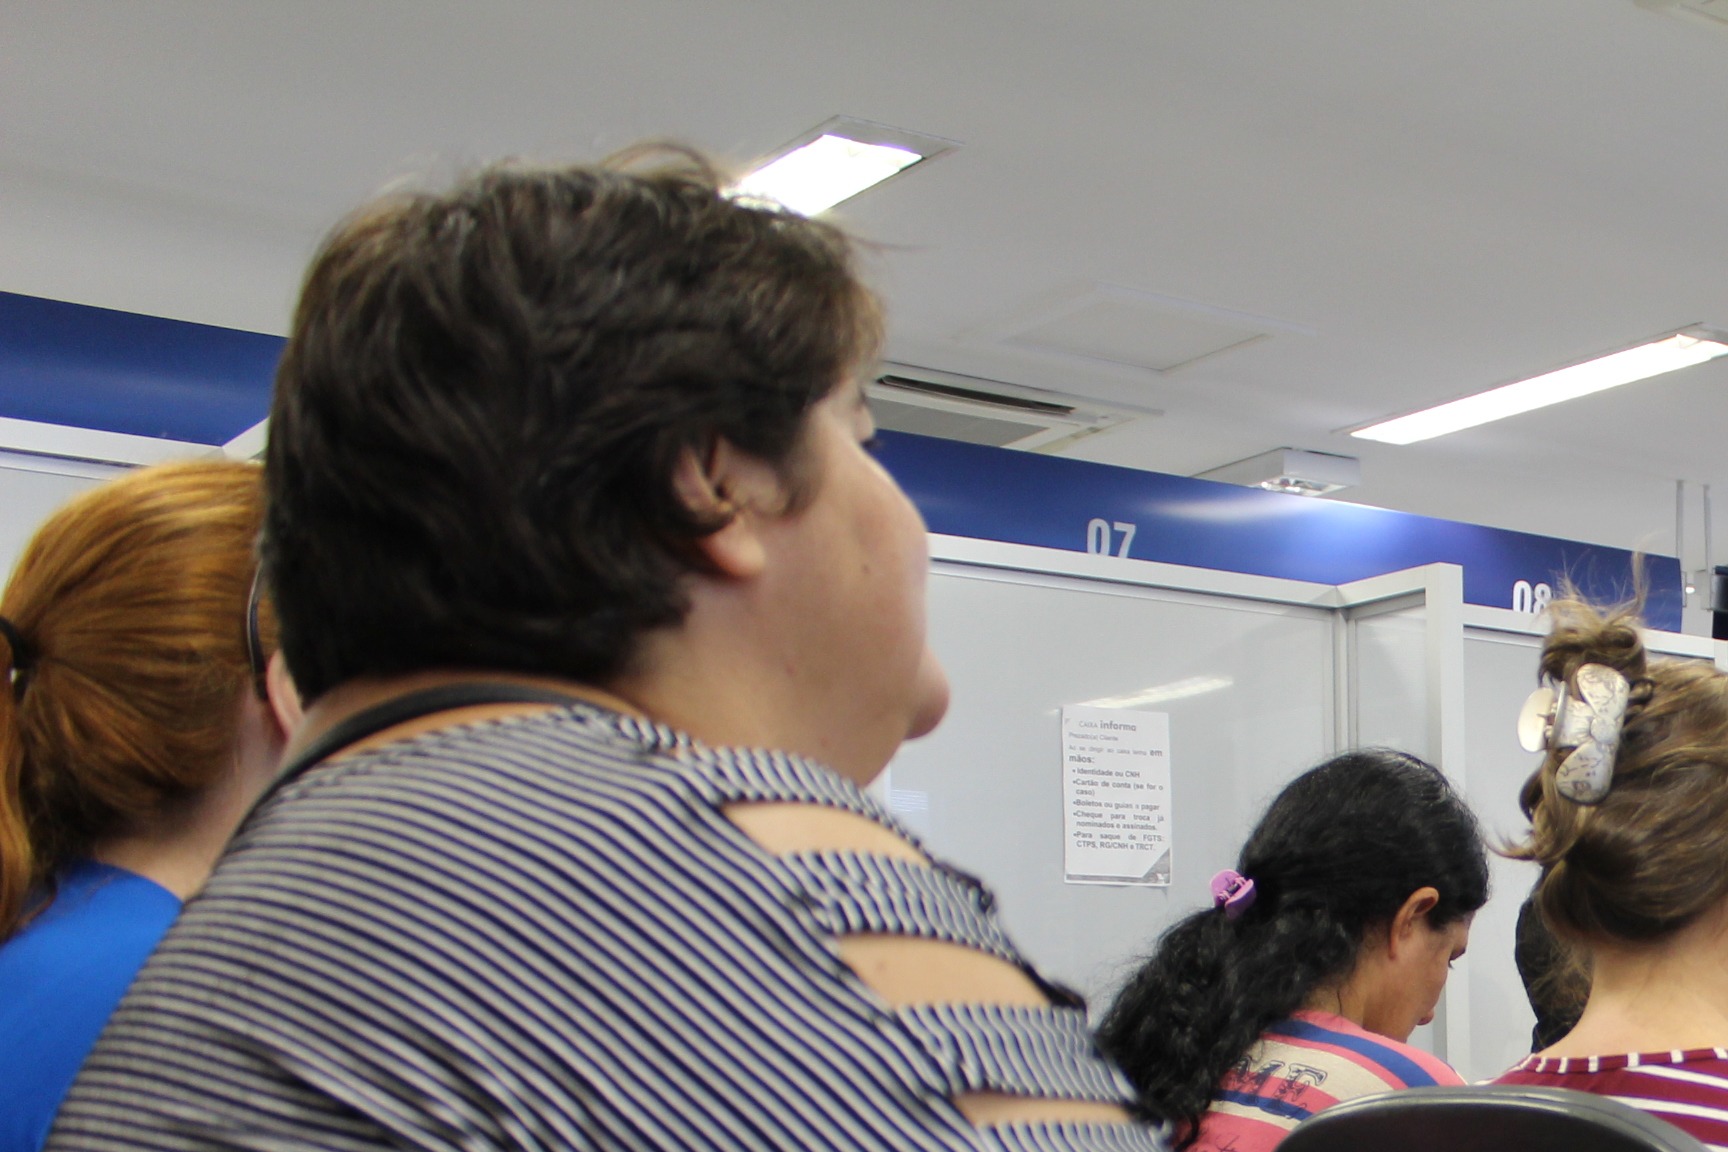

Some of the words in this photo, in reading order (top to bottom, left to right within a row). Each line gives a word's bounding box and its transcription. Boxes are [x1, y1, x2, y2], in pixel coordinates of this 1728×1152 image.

[1086, 518, 1137, 558] 07
[1512, 580, 1553, 614] 08
[1100, 720, 1137, 732] informa
[1150, 749, 1163, 757] em
[1077, 767, 1113, 777] Identidade
[1125, 769, 1140, 778] CNH
[1076, 778, 1099, 787] Cartão
[1112, 781, 1131, 789] conta
[1076, 798, 1102, 807] Boletos
[1141, 803, 1160, 812] pagar
[1076, 810, 1103, 819] Cheque
[1110, 812, 1125, 820] para
[1076, 820, 1114, 829] nominados
[1076, 830, 1093, 838] Para
[1100, 833, 1120, 841] saque
